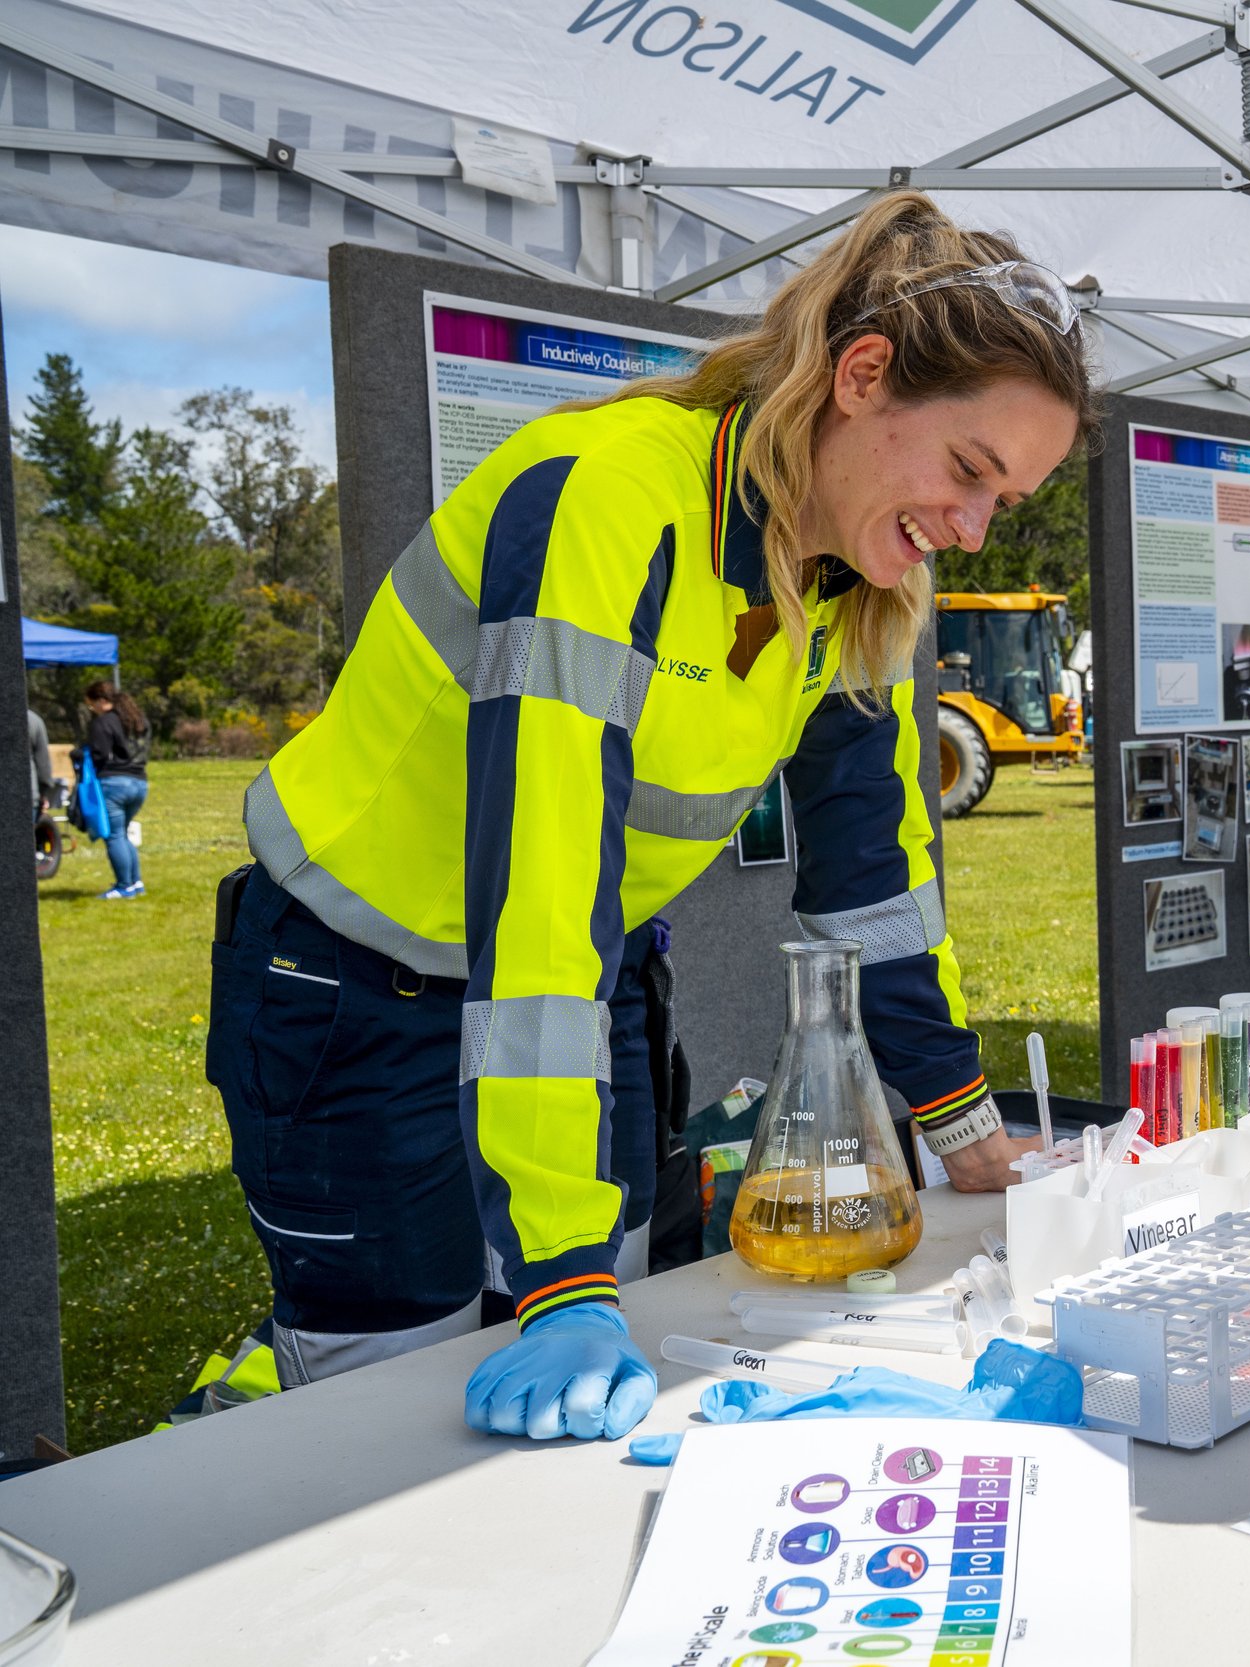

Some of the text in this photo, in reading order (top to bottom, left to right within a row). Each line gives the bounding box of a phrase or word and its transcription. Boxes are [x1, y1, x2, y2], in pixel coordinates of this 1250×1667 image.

[541, 343, 601, 370] Inductively
[602, 354, 644, 376] Coupled
[656, 657, 713, 683] LYSSE
[273, 956, 297, 970] Bisley
[791, 1111, 815, 1121] 1000
[827, 1138, 859, 1152] 1000
[787, 1159, 806, 1168] 800
[838, 1152, 854, 1164] ml
[784, 1195, 803, 1205] 600
[812, 1167, 823, 1233] approx.vol.
[832, 1197, 871, 1217] SIMAX
[781, 1224, 801, 1233] 400
[831, 1213, 872, 1230] CZECH REPUBLIC
[1128, 1213, 1197, 1253] Vinegar
[733, 1349, 766, 1372] Green
[867, 1442, 885, 1486] Drain Cleaner
[979, 1457, 1000, 1474] 14
[978, 1479, 999, 1497] 13
[1025, 1463, 1040, 1497] Alkaline
[776, 1483, 790, 1507] Bleach
[861, 1506, 873, 1525] Soap
[975, 1501, 997, 1520] 12
[747, 1527, 764, 1564] Ammonia
[763, 1530, 779, 1561] Solution
[972, 1528, 995, 1546] 11
[834, 1551, 850, 1587] Stomach
[851, 1553, 866, 1581] Tablets
[969, 1553, 993, 1575] 10
[746, 1575, 768, 1618] Baking Soda
[965, 1584, 988, 1596] 9
[963, 1607, 987, 1617] 8
[686, 1630, 712, 1651] pH
[702, 1604, 730, 1636] Scale
[958, 1625, 982, 1634] 7
[954, 1640, 978, 1648] 6
[950, 1656, 975, 1665] 5
